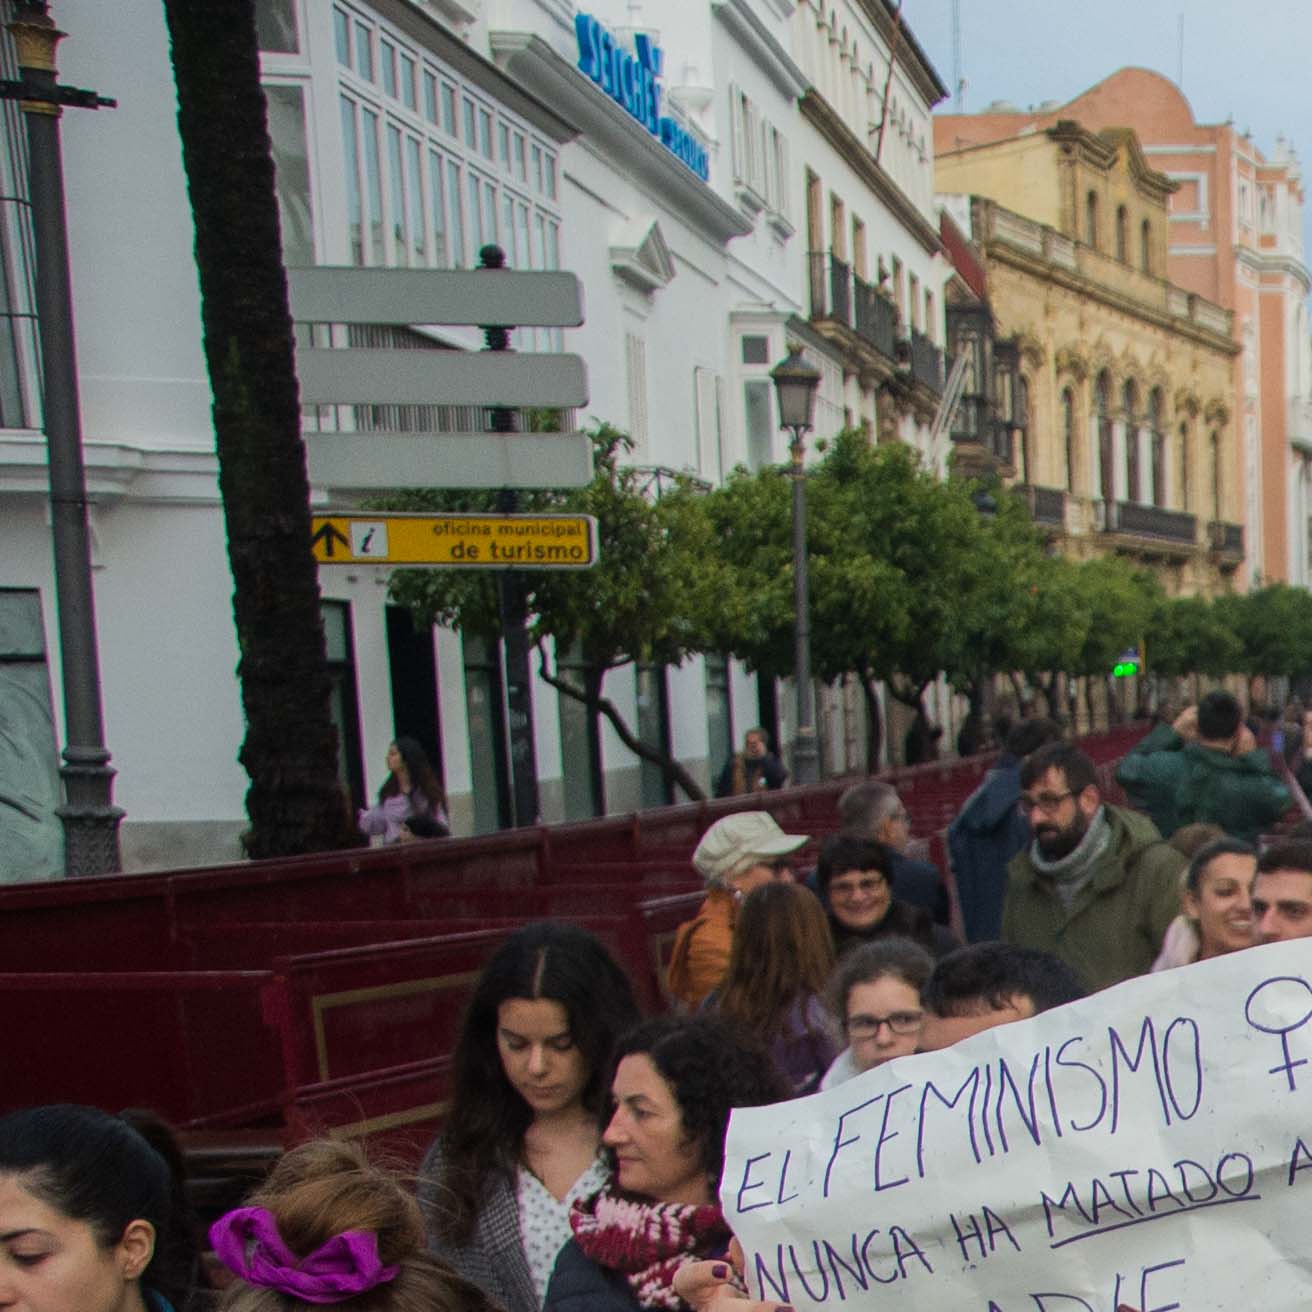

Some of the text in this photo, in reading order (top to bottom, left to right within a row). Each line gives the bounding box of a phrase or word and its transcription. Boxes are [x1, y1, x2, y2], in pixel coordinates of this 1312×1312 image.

[433, 520, 583, 539] oficina municipal
[450, 541, 584, 559] de turismo
[737, 1016, 1202, 1214] EL FEMINISMO
[755, 1225, 931, 1303] NUNCA
[956, 1206, 1021, 1262] HA
[1040, 1152, 1254, 1238] MATADO
